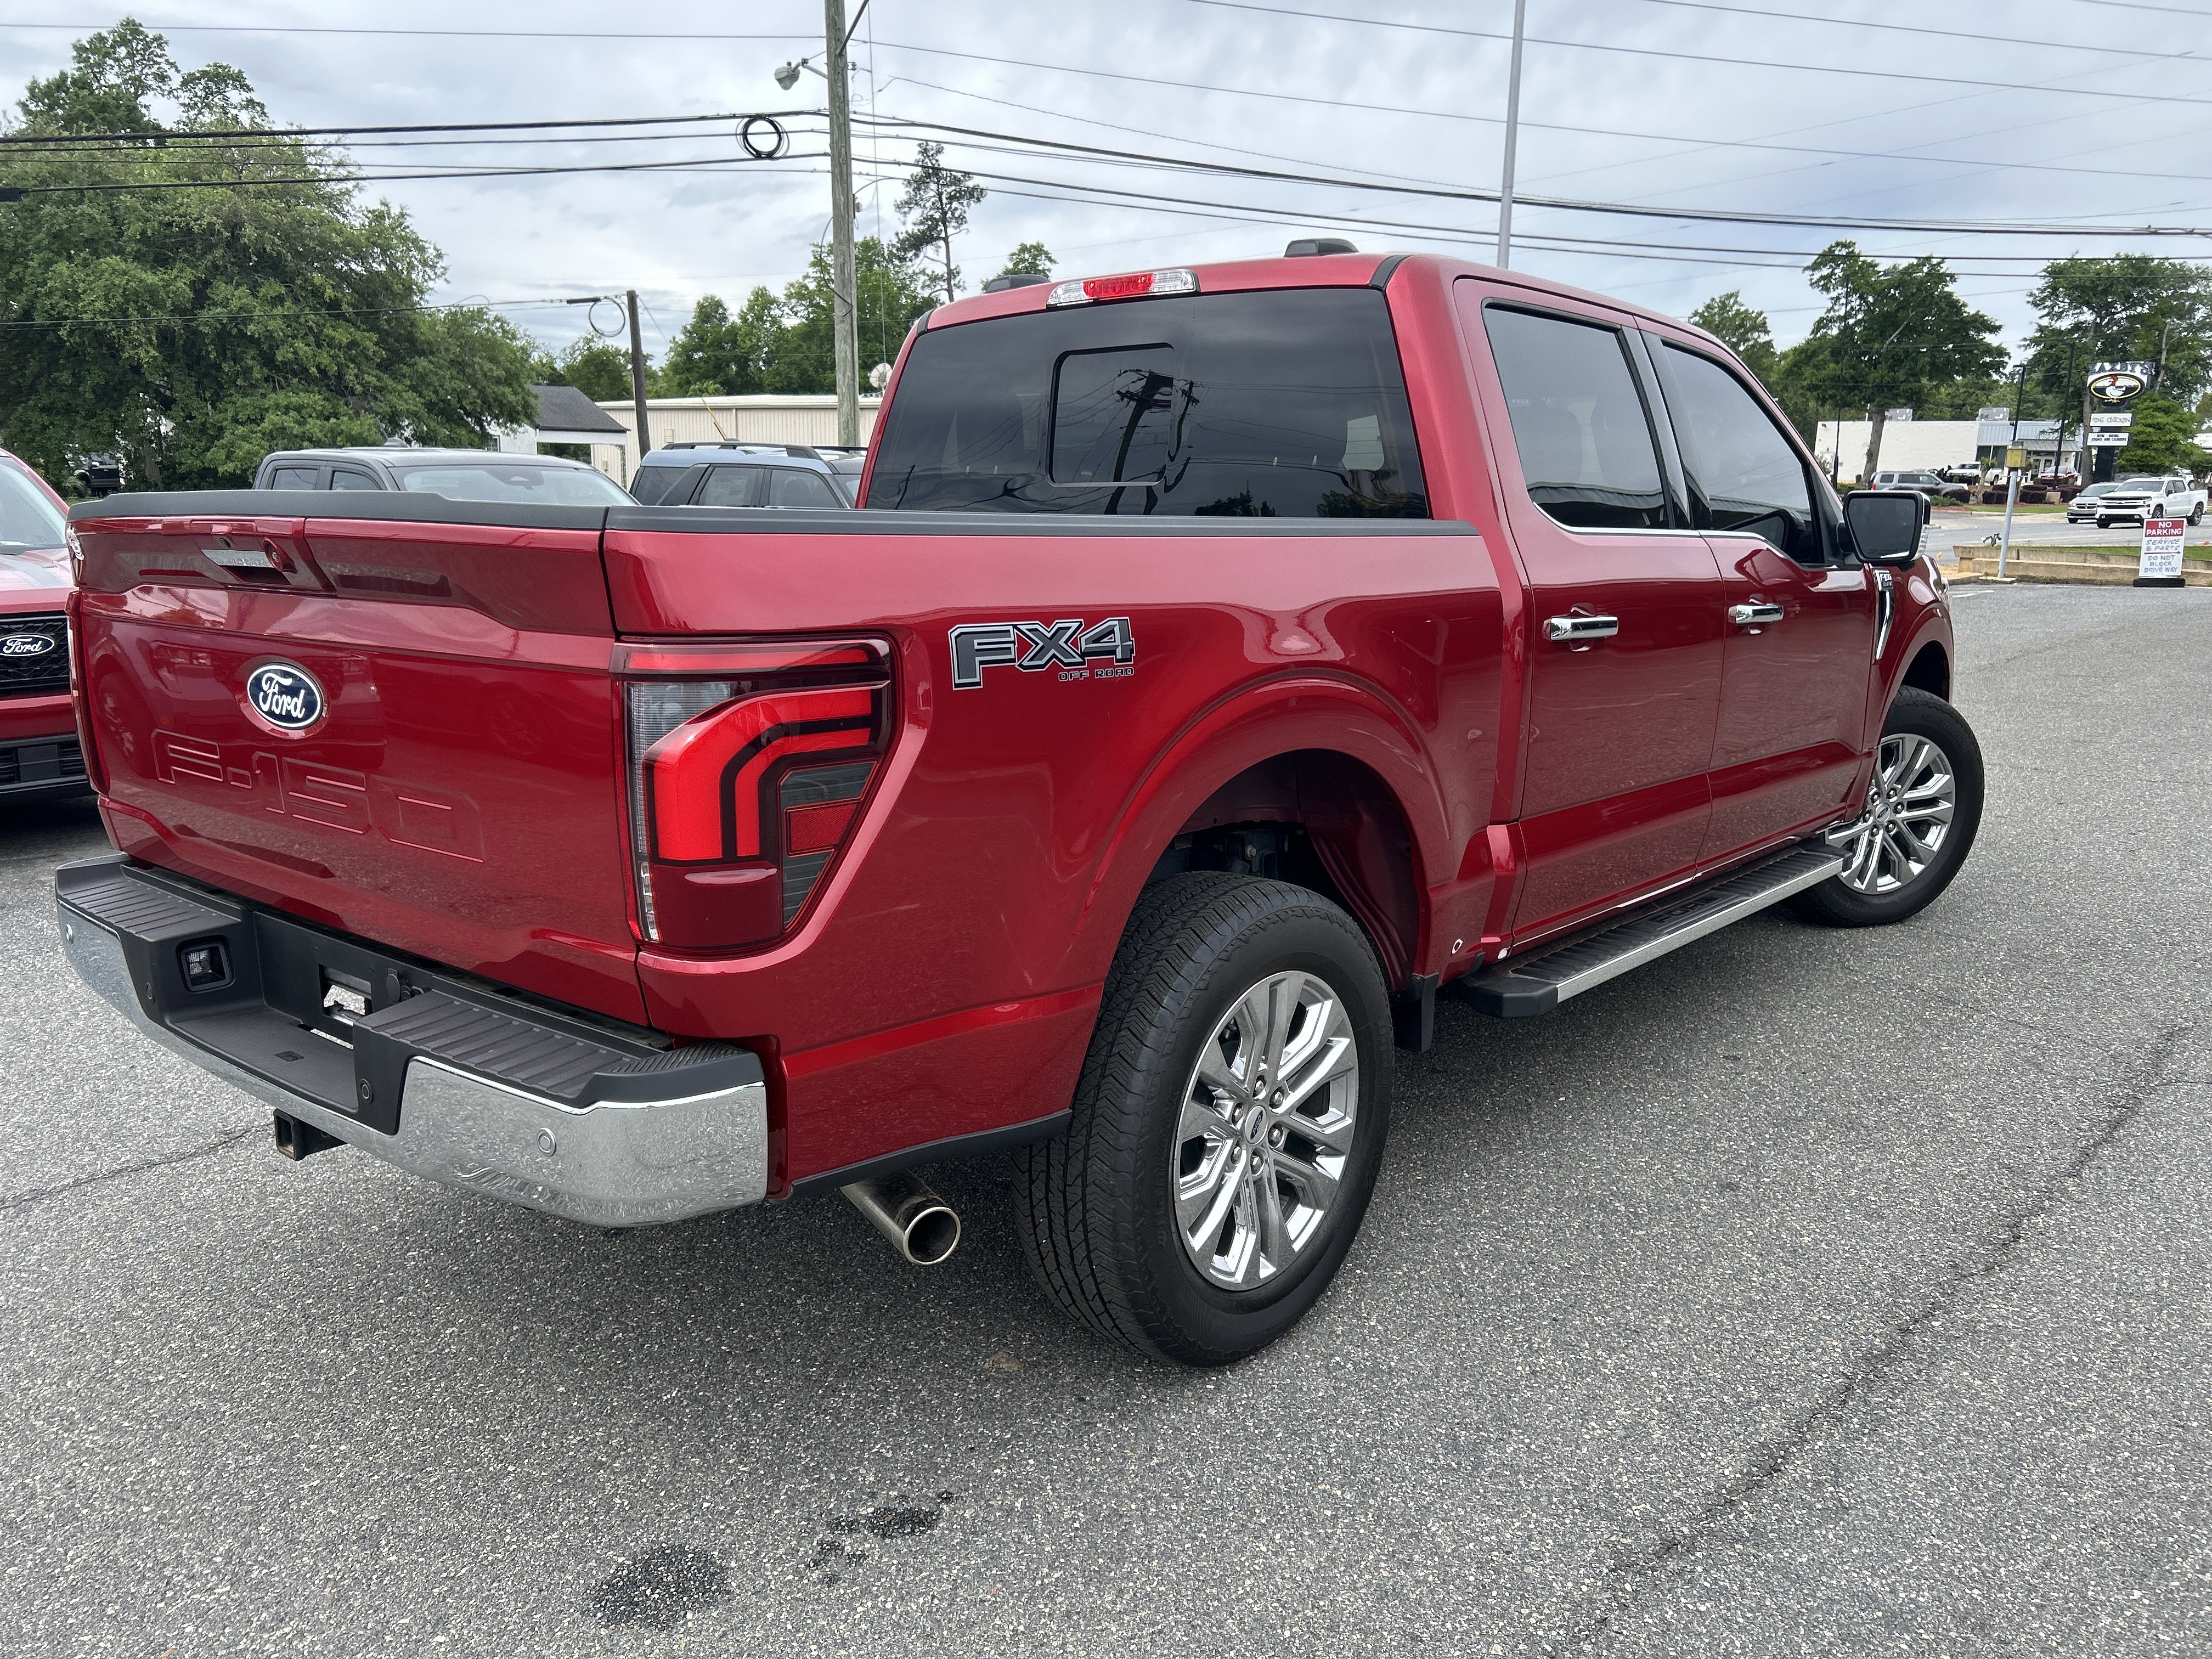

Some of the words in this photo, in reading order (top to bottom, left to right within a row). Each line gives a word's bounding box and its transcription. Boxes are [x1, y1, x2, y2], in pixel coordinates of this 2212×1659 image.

[3, 637, 42, 653] Ford
[948, 616, 1135, 691] FX4
[258, 672, 306, 719] Ford
[1058, 670, 1090, 682] OFF
[1095, 667, 1135, 679] ROAD
[151, 728, 484, 864] F-150
